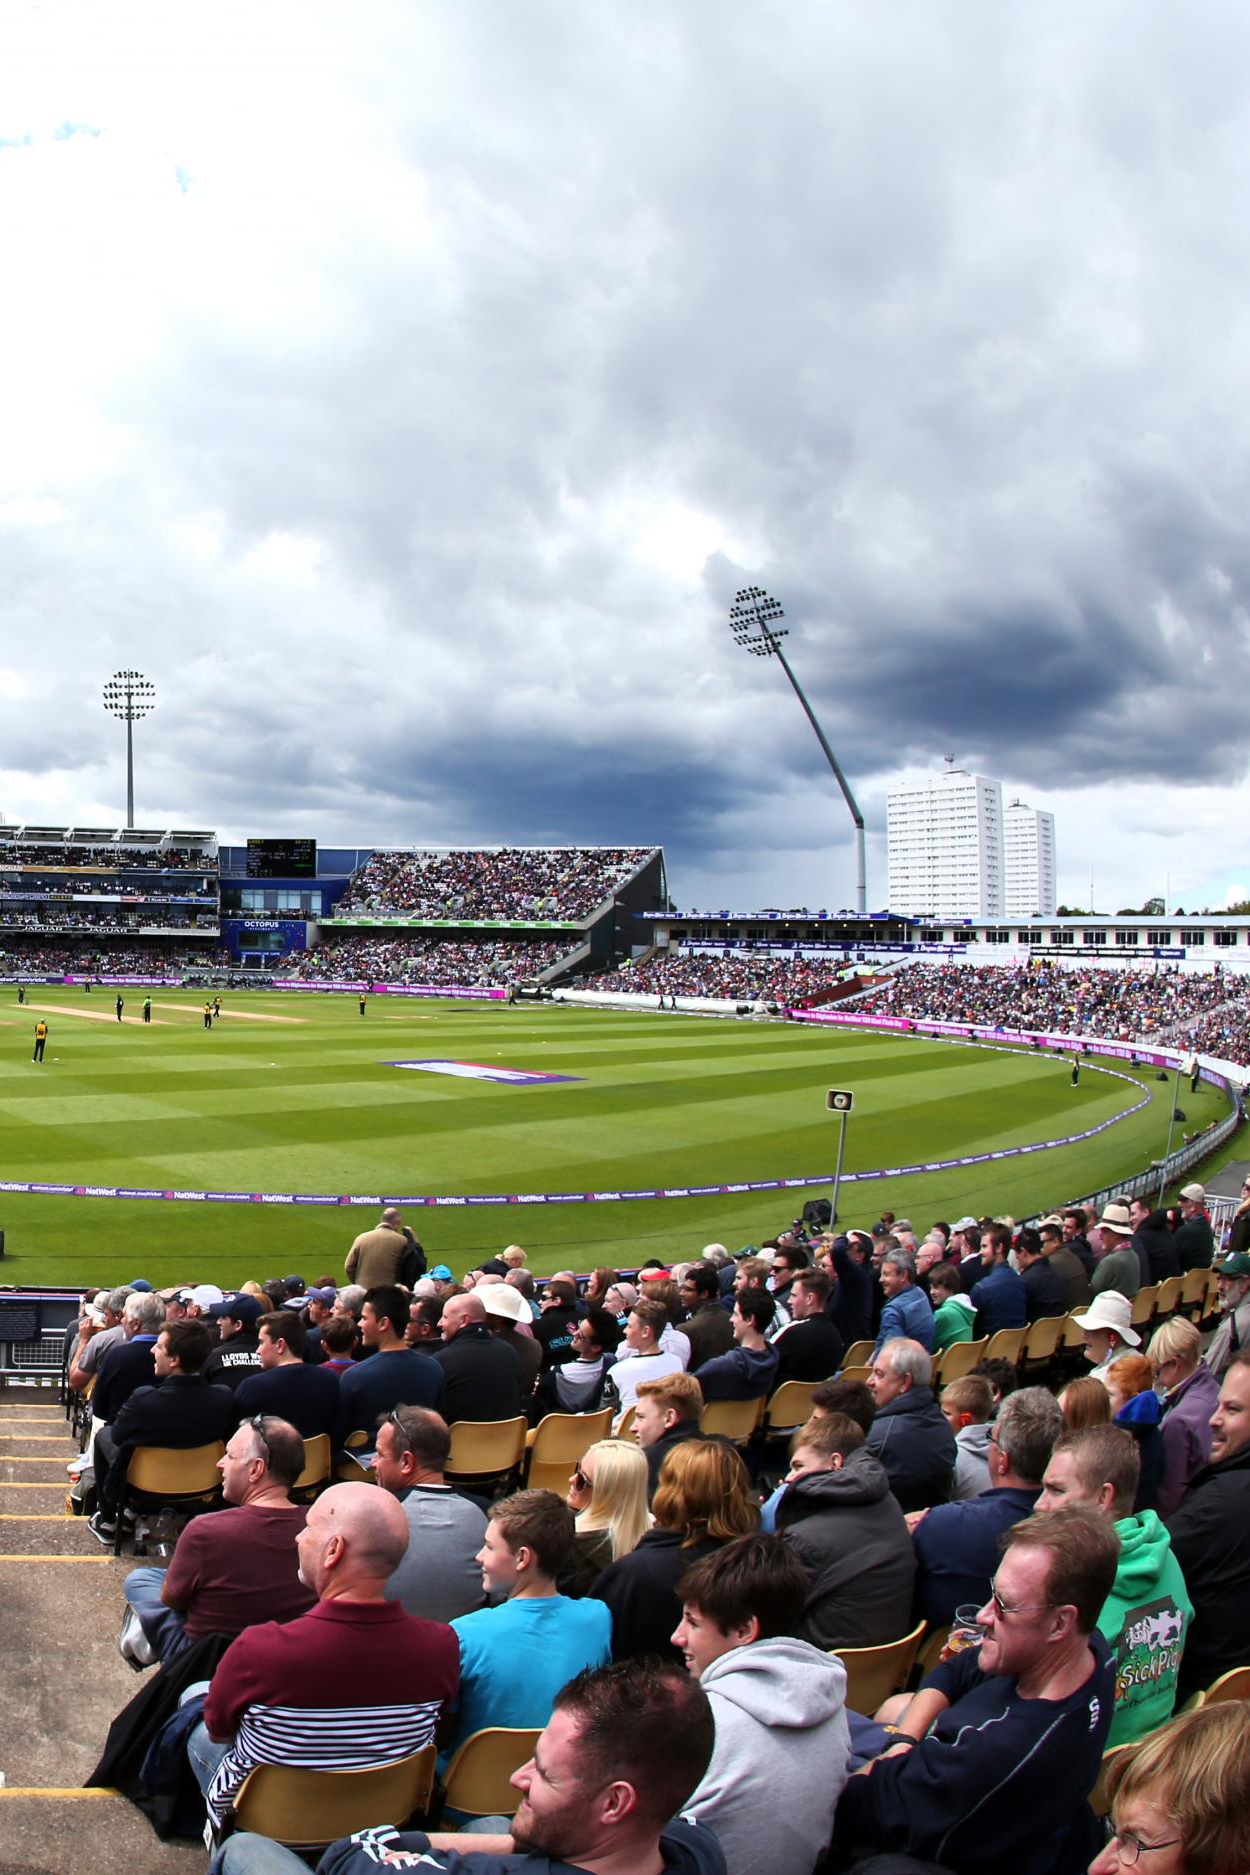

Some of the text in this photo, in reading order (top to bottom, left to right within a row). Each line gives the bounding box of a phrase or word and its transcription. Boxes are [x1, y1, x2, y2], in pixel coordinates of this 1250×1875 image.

[0, 1182, 28, 1191] NatWest
[86, 1187, 116, 1195] NatWest
[174, 1191, 205, 1200] NatWest
[262, 1195, 293, 1203] NatWest
[518, 1195, 546, 1203] NatWest
[350, 1196, 381, 1204] NatWest
[436, 1197, 465, 1205] NatWest
